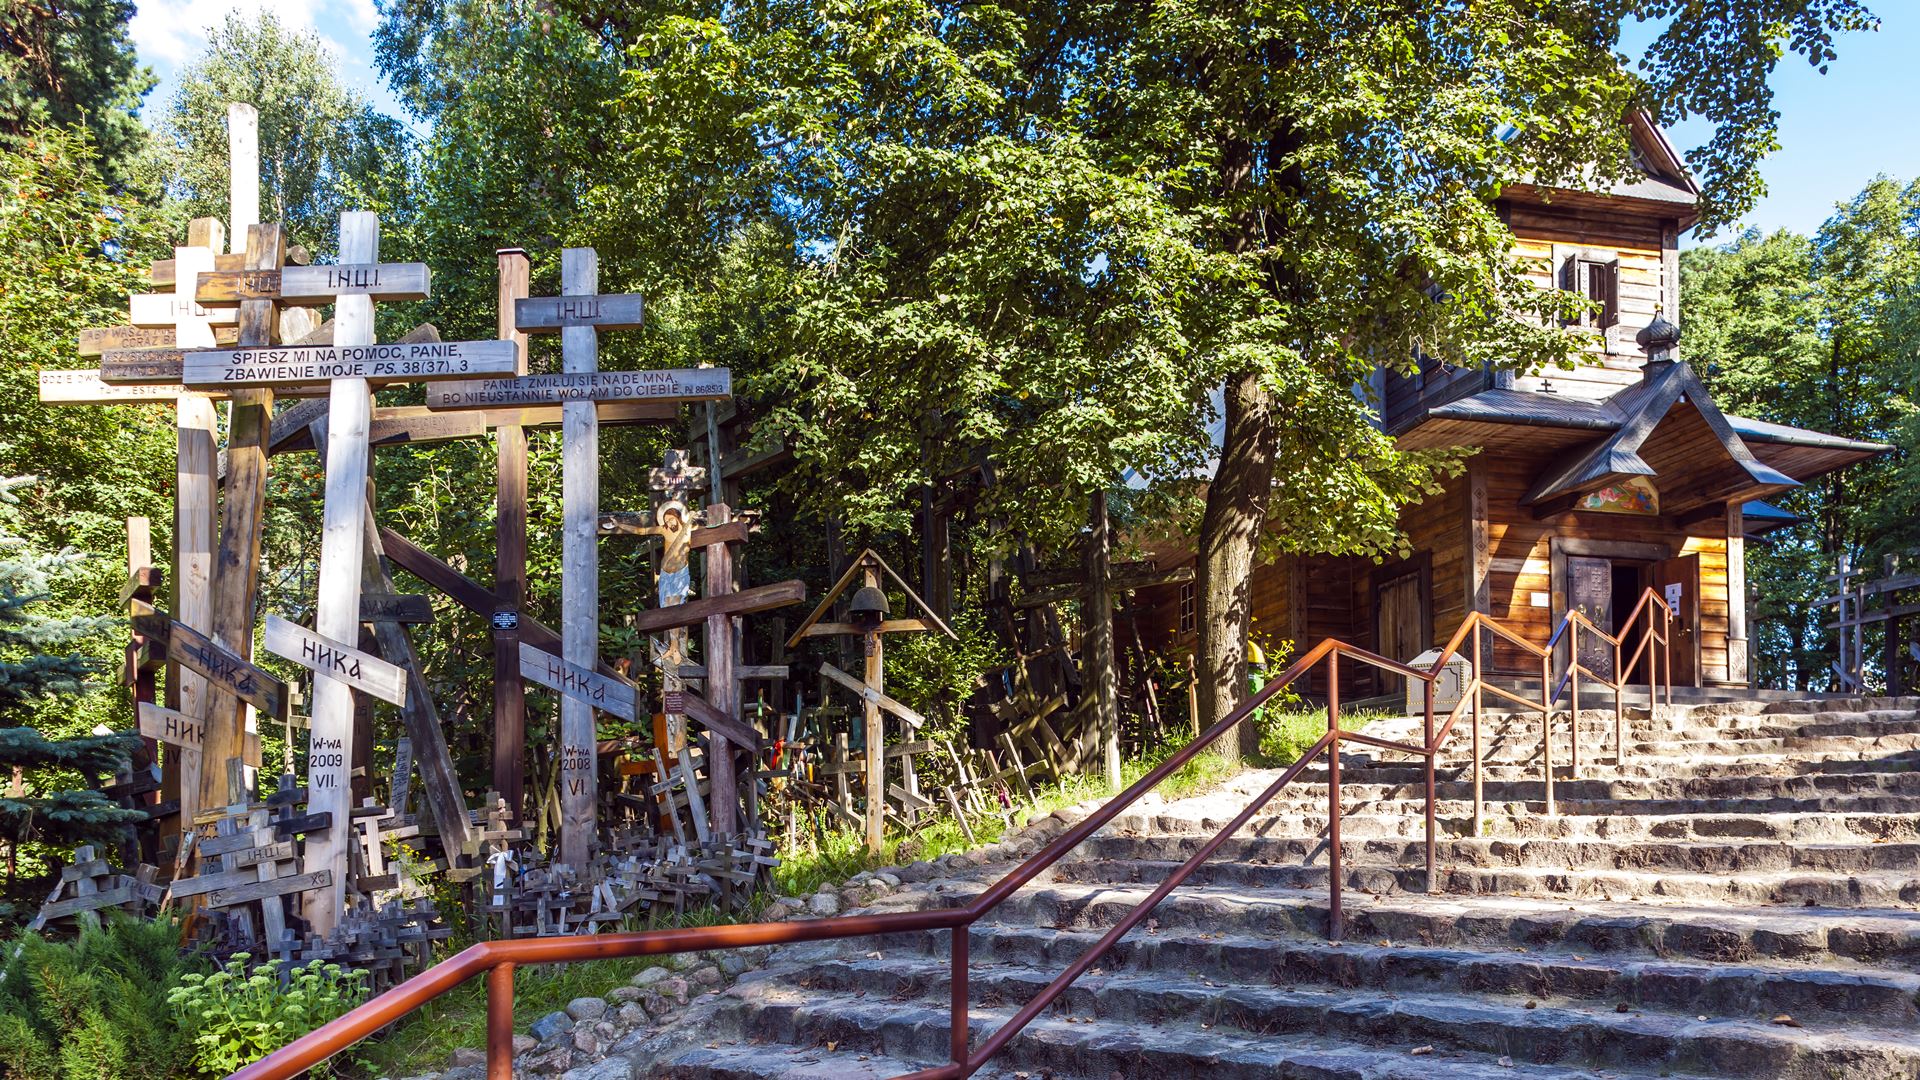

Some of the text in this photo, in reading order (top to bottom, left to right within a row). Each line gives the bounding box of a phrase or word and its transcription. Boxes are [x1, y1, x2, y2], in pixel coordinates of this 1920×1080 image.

[293, 350, 310, 363] MI
[315, 349, 337, 362] NA
[342, 346, 406, 361] POMOC,
[411, 344, 462, 359] PANIE,
[224, 366, 314, 381] ZBAWIENIE
[319, 364, 368, 377] MOJE.
[373, 362, 397, 376] PS.
[460, 360, 468, 372] 3
[528, 377, 576, 388] ZMIŁUJ
[602, 373, 639, 385] NADE
[443, 393, 461, 404] BO
[465, 389, 553, 403] NIEUSTANNIE
[557, 387, 609, 399] WOŁAM
[614, 386, 632, 396] DO
[310, 753, 343, 768] 2009
[563, 758, 591, 771] 2008
